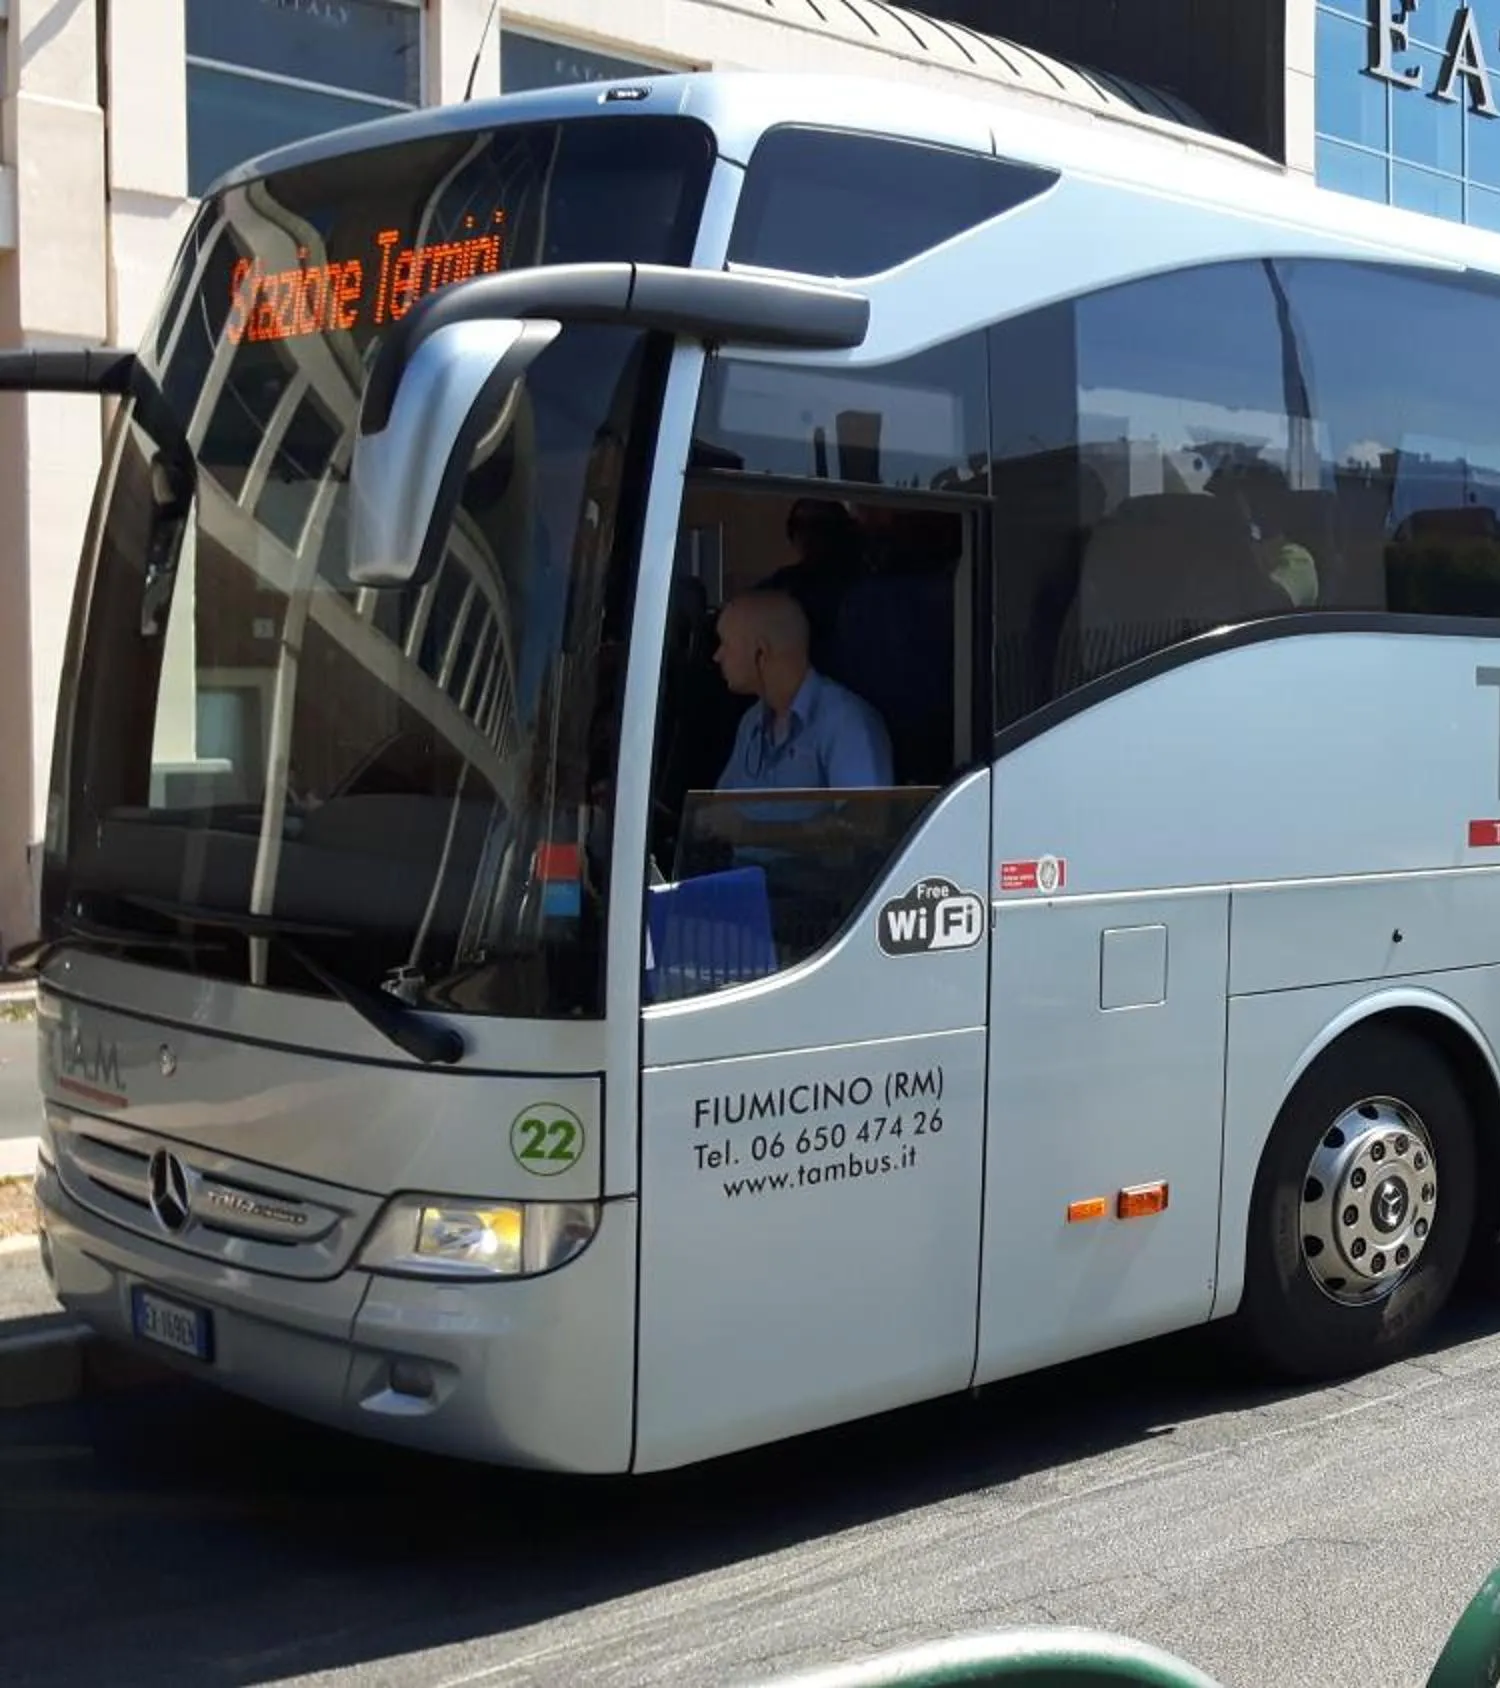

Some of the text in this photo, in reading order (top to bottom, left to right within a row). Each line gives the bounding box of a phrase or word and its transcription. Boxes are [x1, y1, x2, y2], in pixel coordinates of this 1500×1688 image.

[228, 246, 362, 345] Stazione
[917, 884, 950, 899] Free
[694, 1065, 944, 1129] FIUMICINO (RM)
[520, 1119, 577, 1159] 22
[694, 1106, 944, 1169] Tel. 06 650 474 26
[723, 1144, 918, 1199] www.tambus.it
